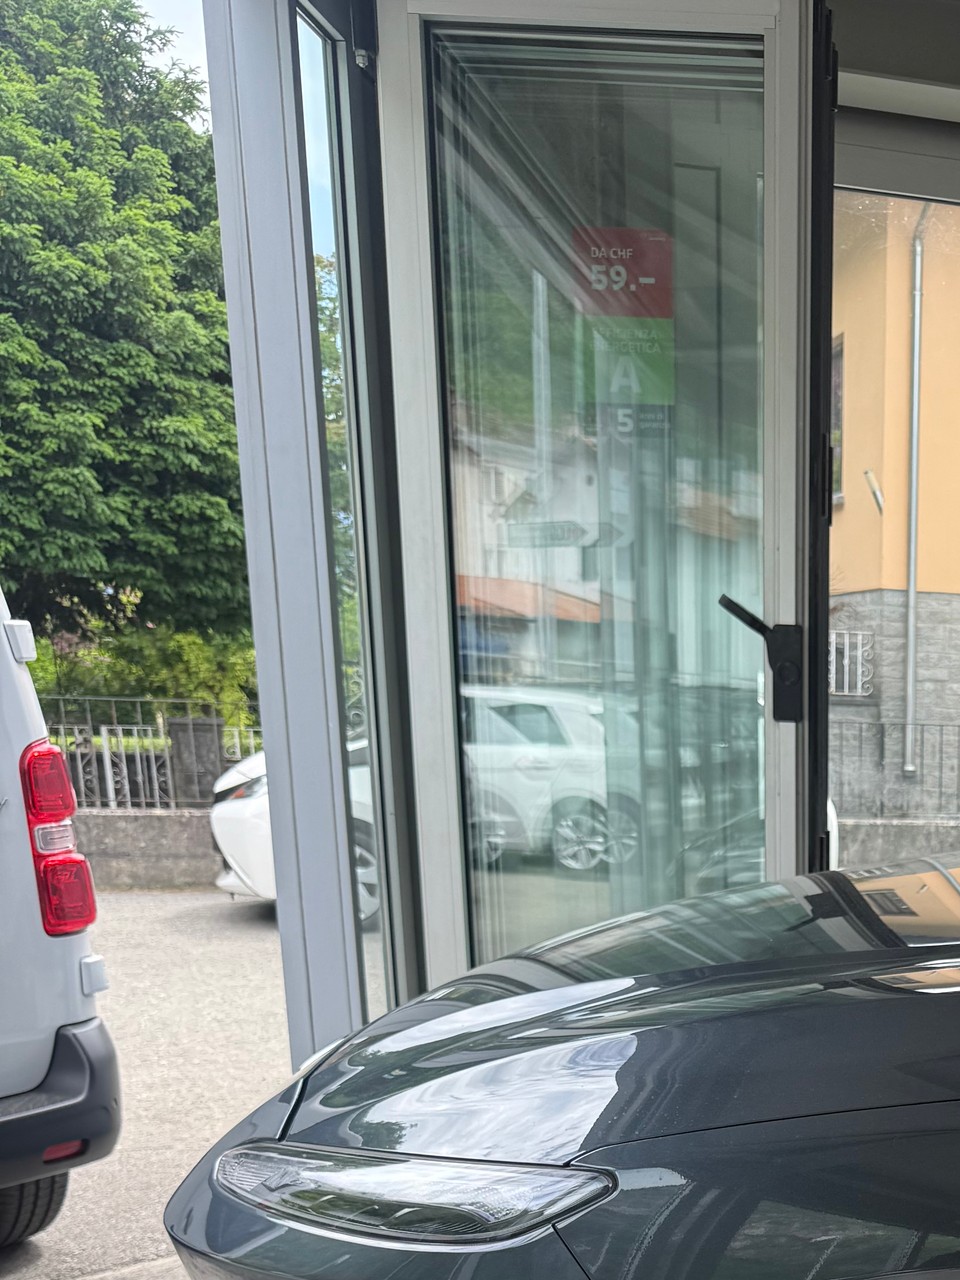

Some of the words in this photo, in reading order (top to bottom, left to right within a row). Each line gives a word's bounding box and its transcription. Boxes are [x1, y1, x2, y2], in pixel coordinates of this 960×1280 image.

[591, 248, 607, 258] DA
[610, 248, 633, 259] CHF
[591, 264, 656, 291] 59.-
[610, 355, 641, 393] A
[617, 409, 634, 433] 5
